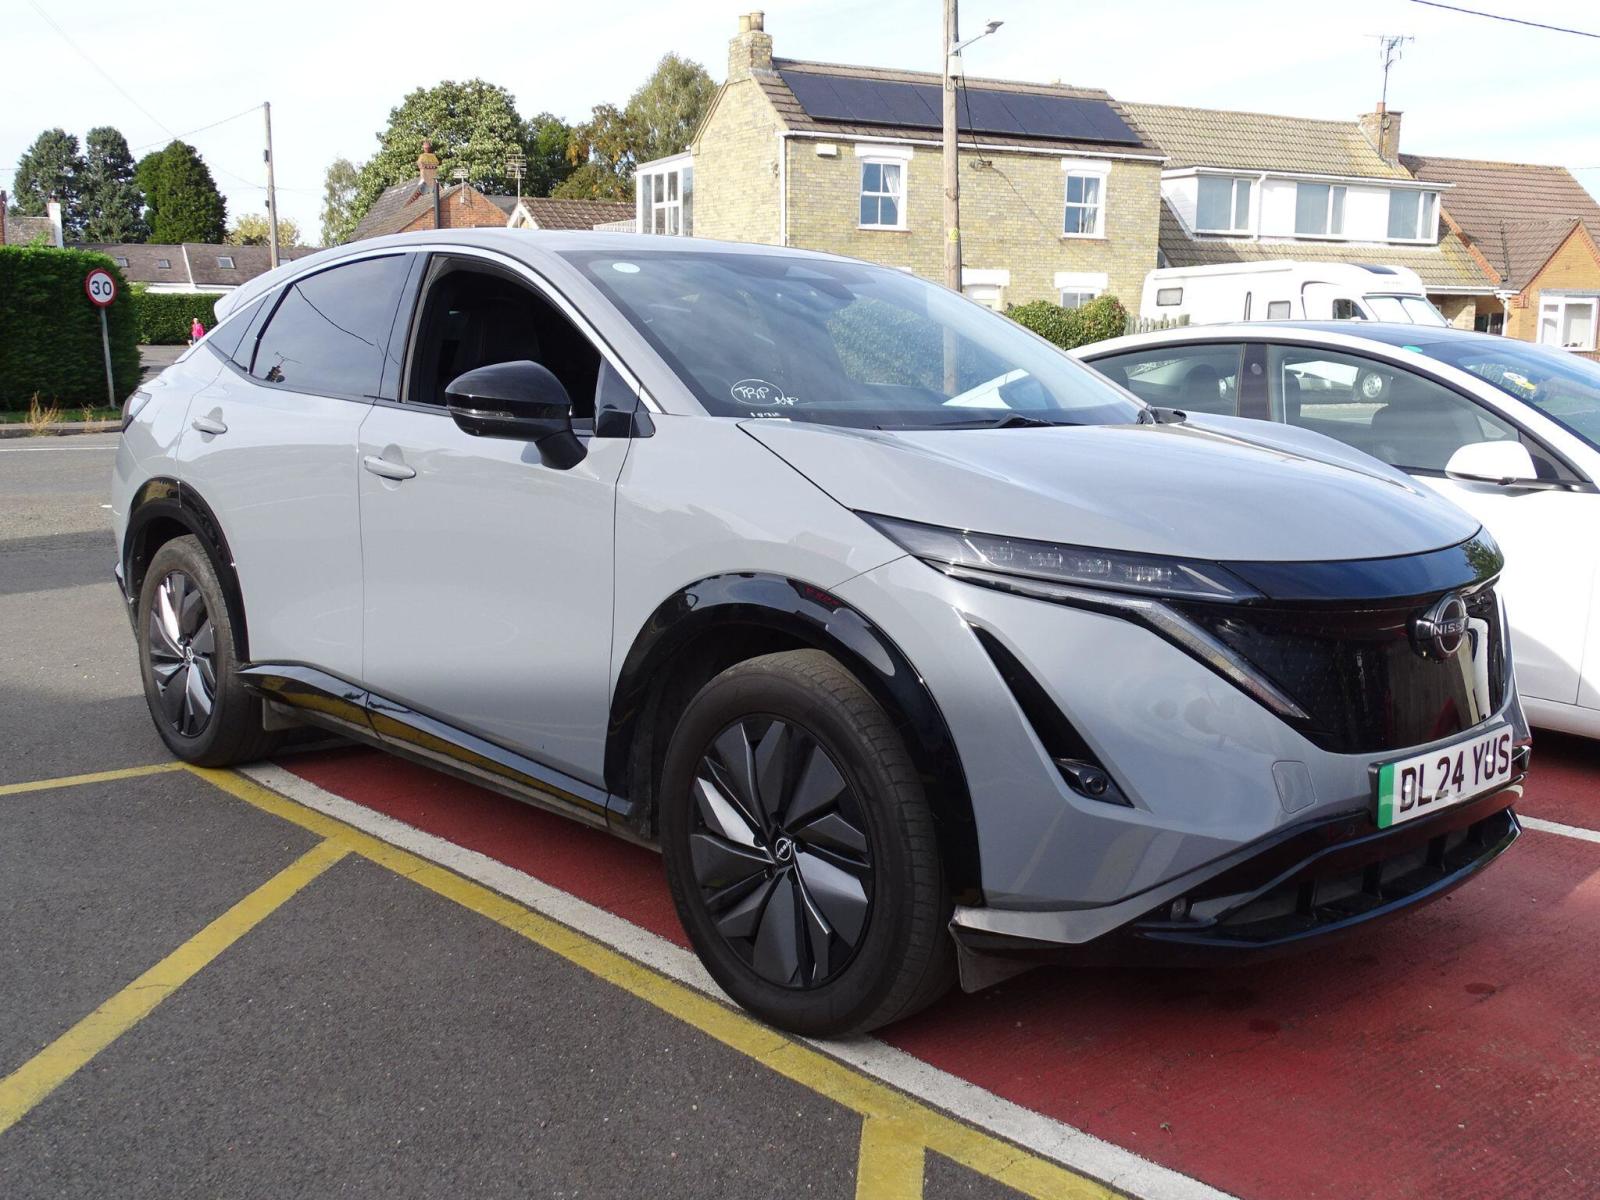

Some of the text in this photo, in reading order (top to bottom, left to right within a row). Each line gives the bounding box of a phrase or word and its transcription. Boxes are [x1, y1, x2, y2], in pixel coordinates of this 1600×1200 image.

[91, 280, 112, 296] 30
[1400, 733, 1510, 813] DL24 YUS
